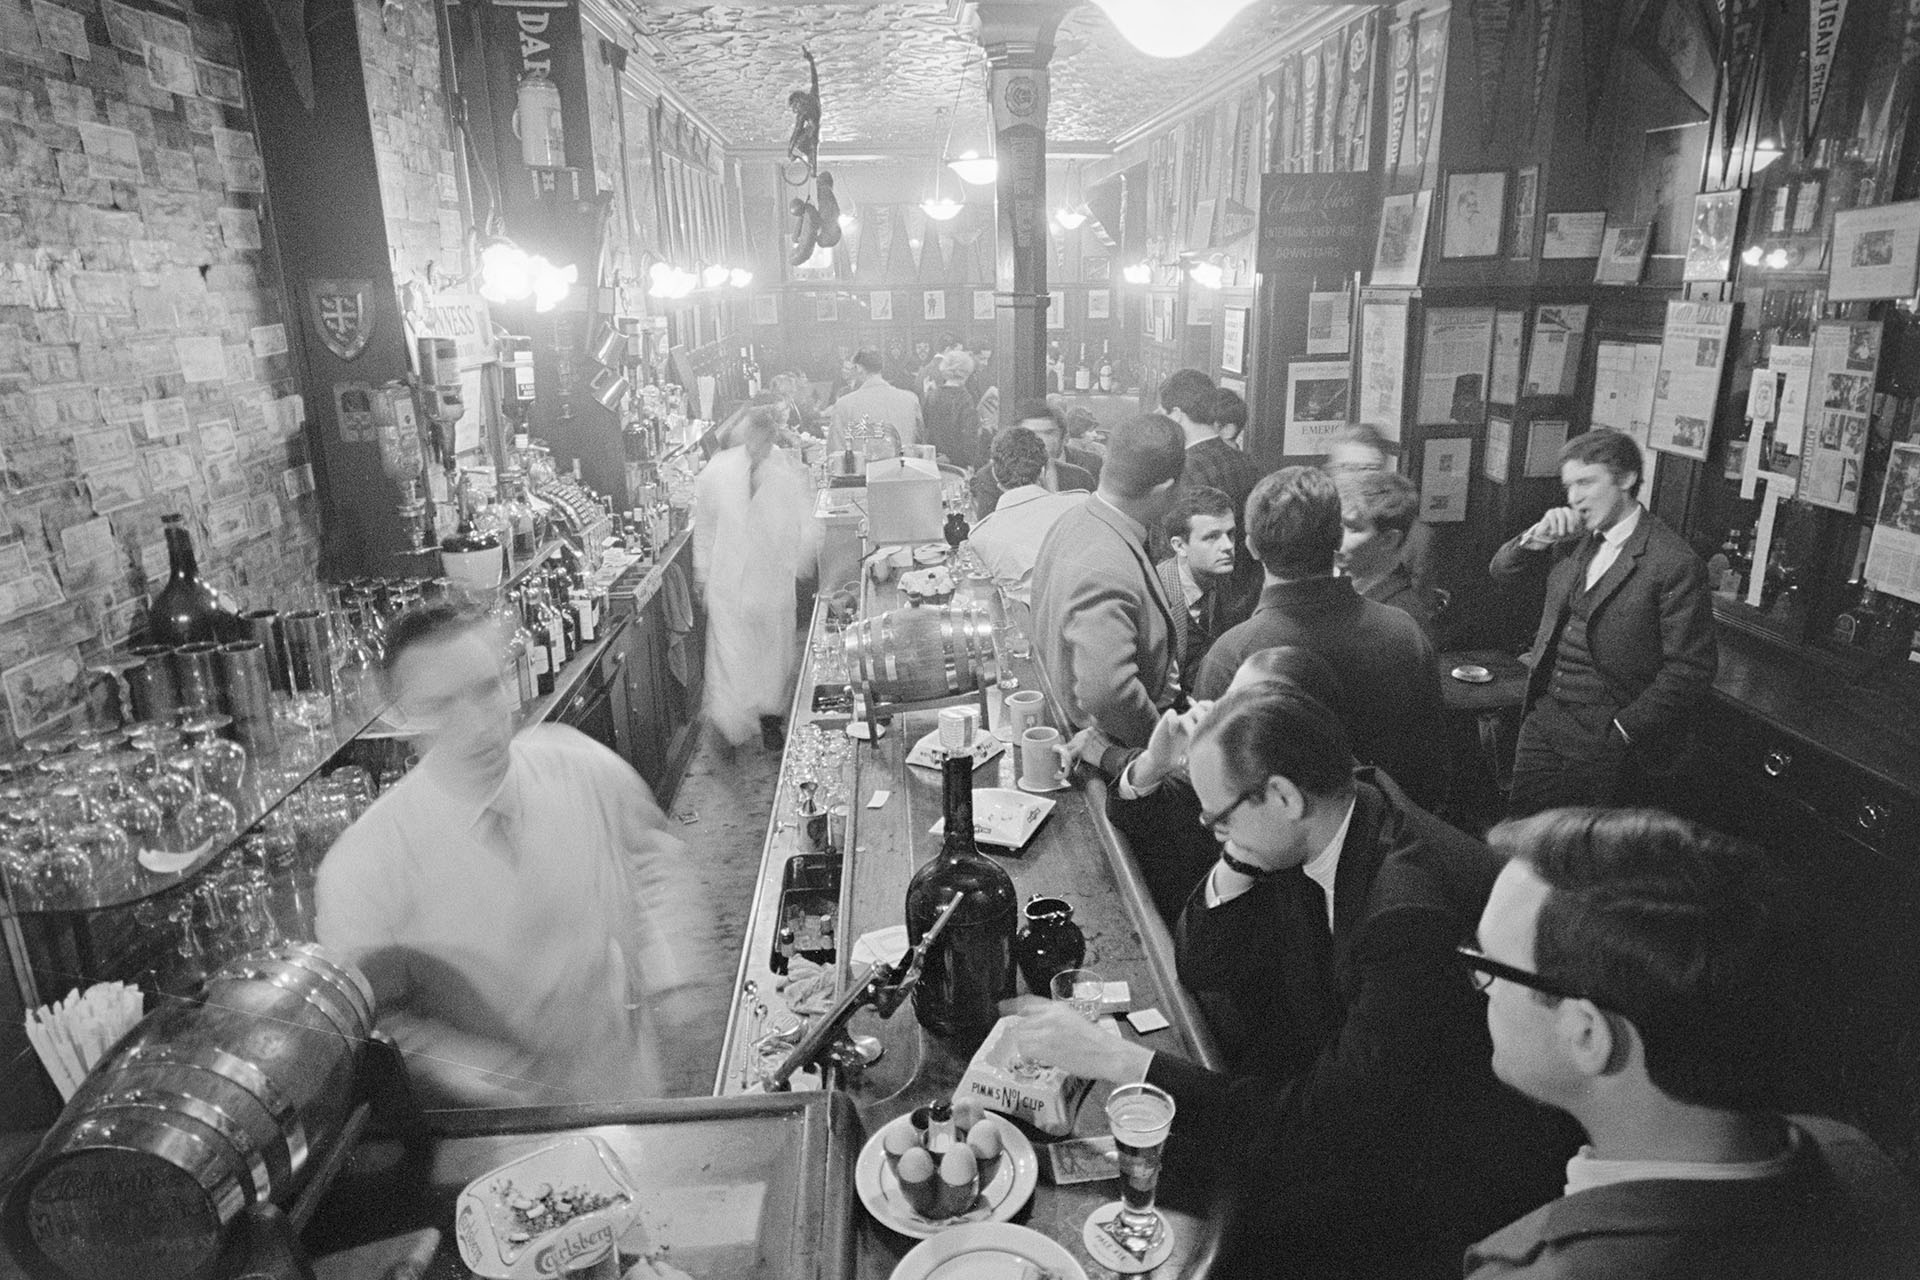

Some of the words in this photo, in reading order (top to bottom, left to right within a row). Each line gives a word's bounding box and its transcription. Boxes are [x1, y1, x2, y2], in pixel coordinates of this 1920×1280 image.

[1810, 63, 1827, 106] STATE
[1389, 70, 1409, 165] OREGON
[1022, 1096, 1045, 1112] CUP
[534, 1225, 614, 1275] Carlsberg
